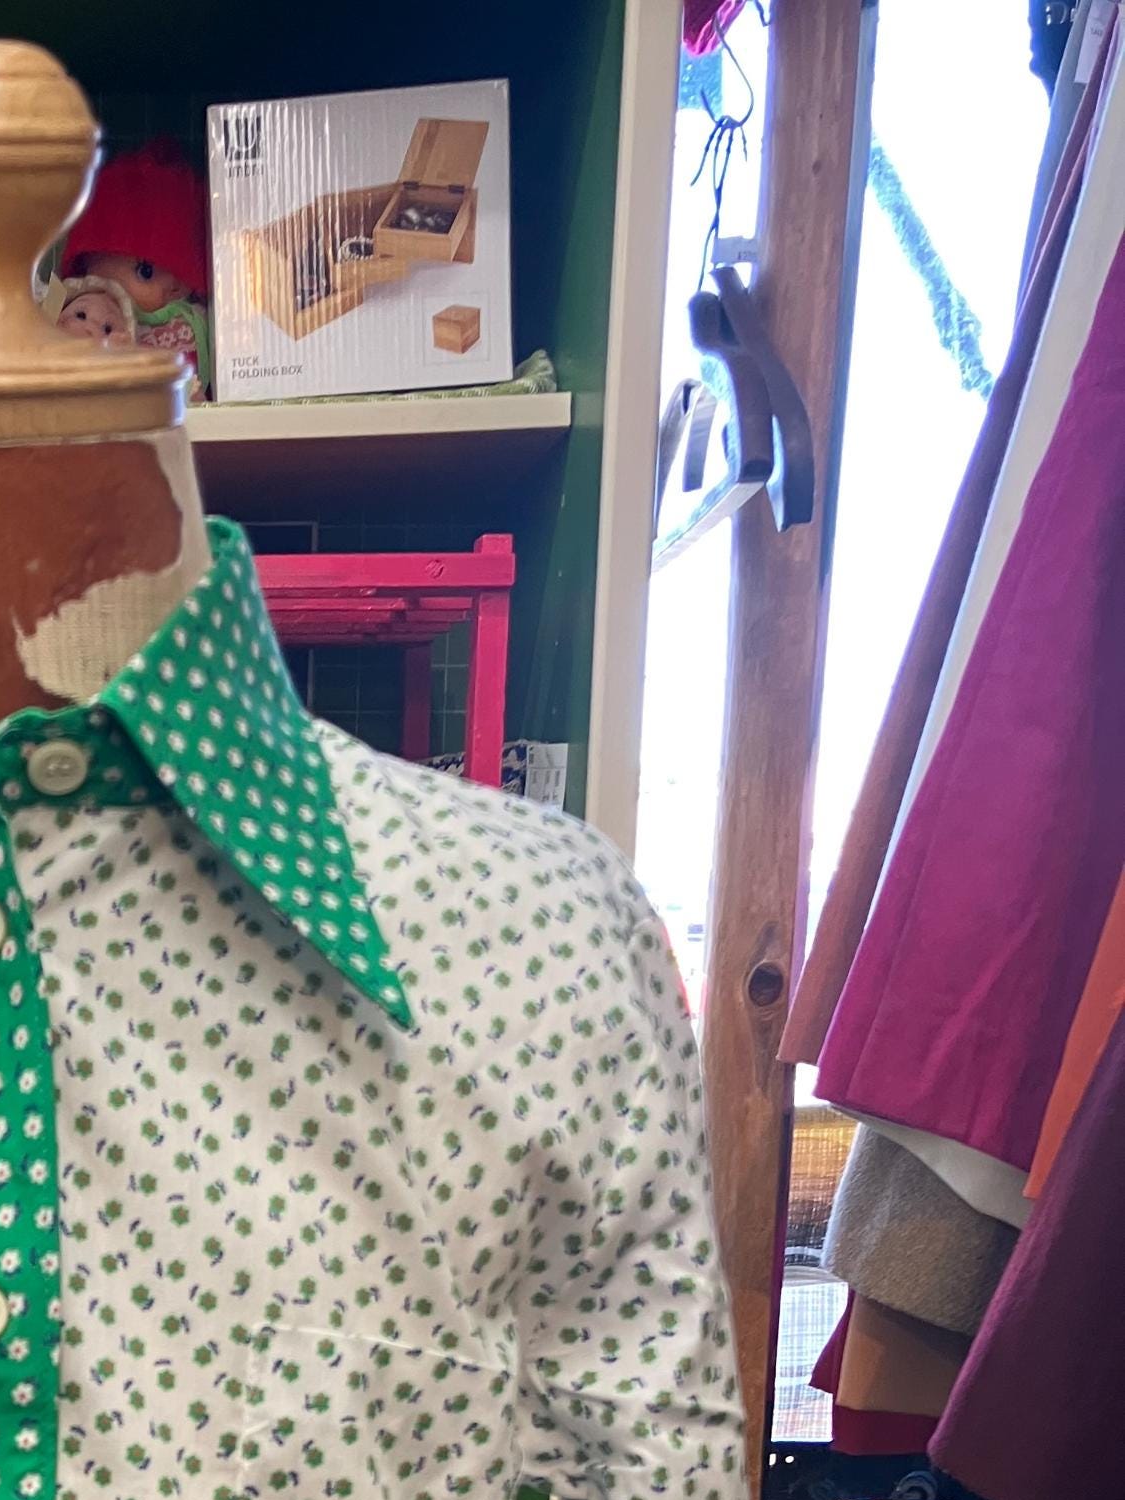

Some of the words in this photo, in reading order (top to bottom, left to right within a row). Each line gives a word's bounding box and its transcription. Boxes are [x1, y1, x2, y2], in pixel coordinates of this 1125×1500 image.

[232, 356, 259, 367] TUCK
[232, 366, 279, 379] FOLDING
[281, 365, 303, 375] BOX
